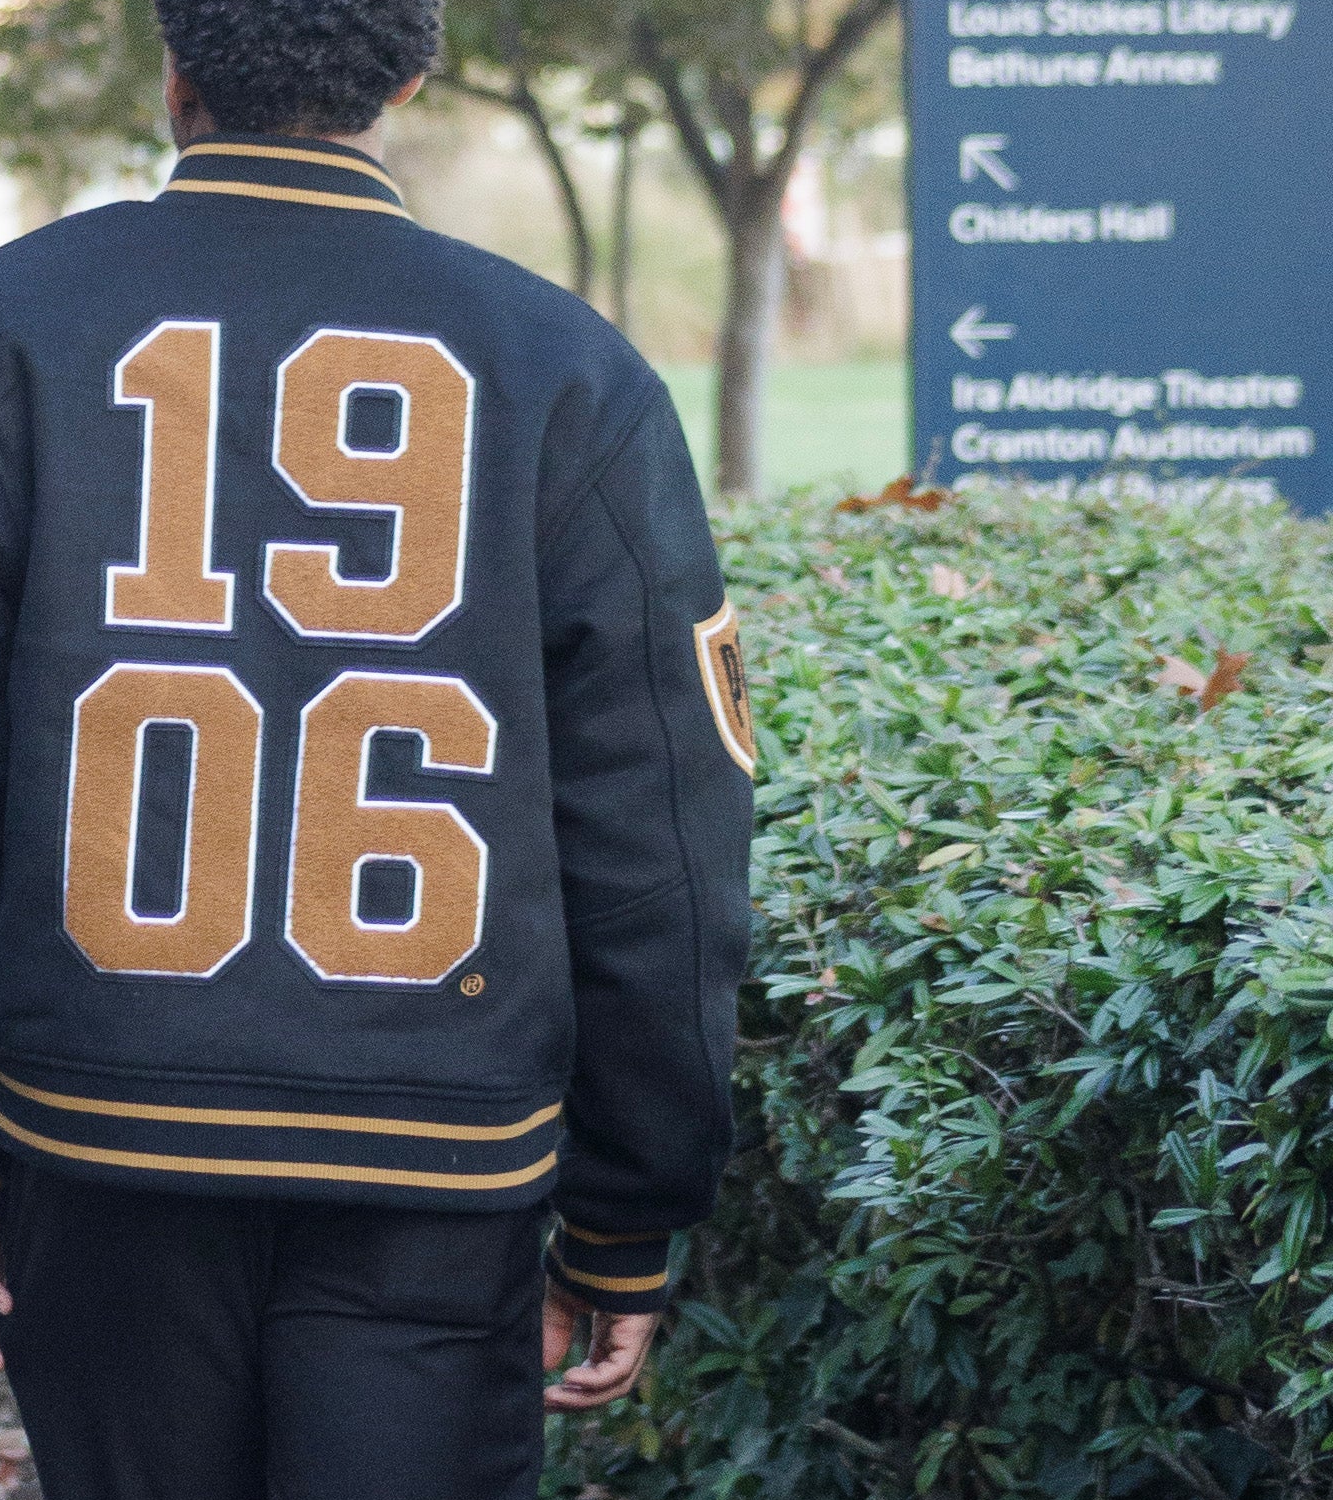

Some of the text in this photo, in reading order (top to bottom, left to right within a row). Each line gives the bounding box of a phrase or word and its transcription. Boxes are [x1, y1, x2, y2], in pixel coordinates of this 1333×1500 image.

[949, 45, 1222, 87] Bethune Annex
[949, 203, 1175, 243] Childers Hall
[951, 370, 1304, 415] Ira Aldridge Theatre
[951, 424, 1314, 463] Cramton Auditorium
[105, 321, 476, 641] 19
[64, 663, 497, 985] 06
